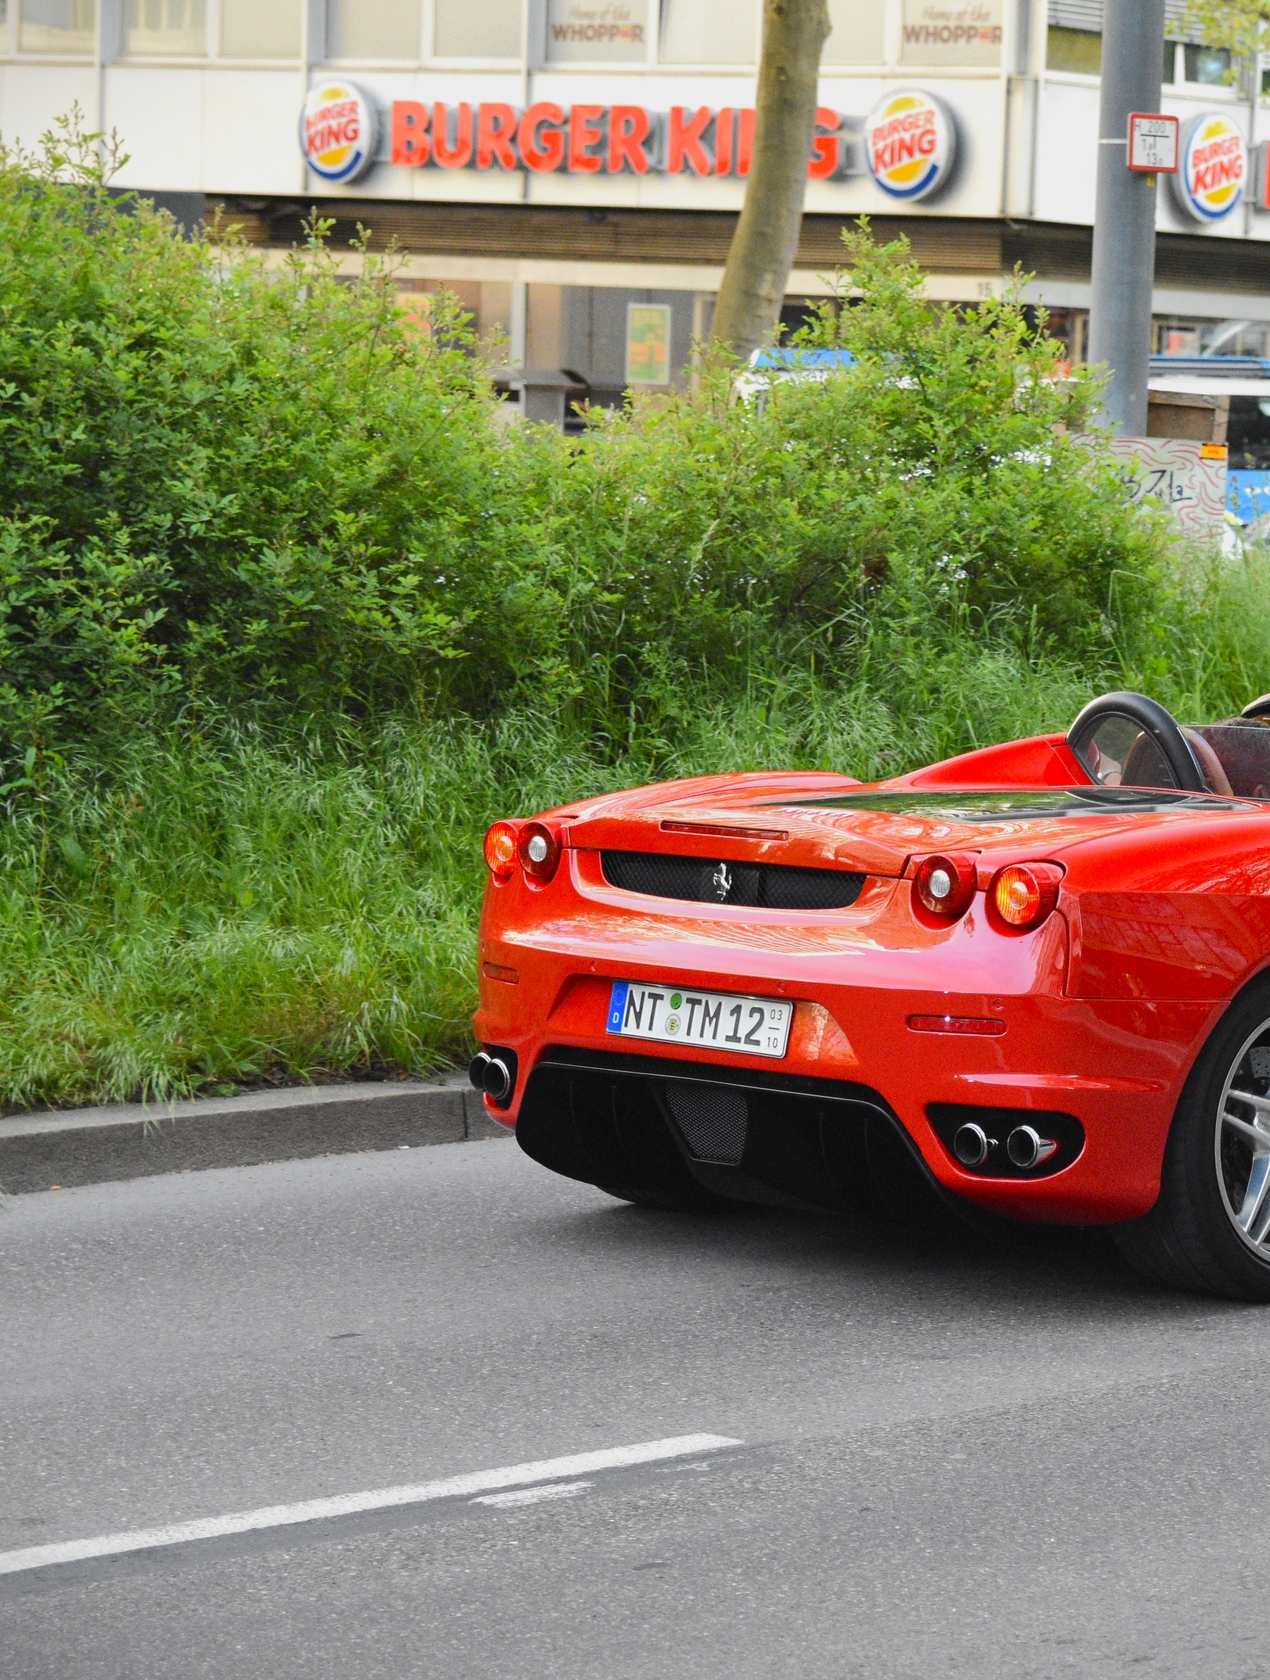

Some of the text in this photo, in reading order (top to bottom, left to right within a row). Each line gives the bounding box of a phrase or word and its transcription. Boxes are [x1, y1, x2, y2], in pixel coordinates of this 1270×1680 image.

[305, 101, 358, 133] BURGER
[872, 110, 935, 147] BURGER
[1147, 121, 1166, 133] 200
[306, 119, 359, 158] KING
[391, 100, 649, 174] BURGER
[872, 129, 937, 175] KING
[1192, 136, 1240, 168] BURGER
[1192, 154, 1242, 196] KING
[612, 1012, 620, 1024] D
[624, 989, 765, 1047] NT TM 12
[769, 1008, 783, 1021] 03
[767, 1036, 779, 1049] 10
